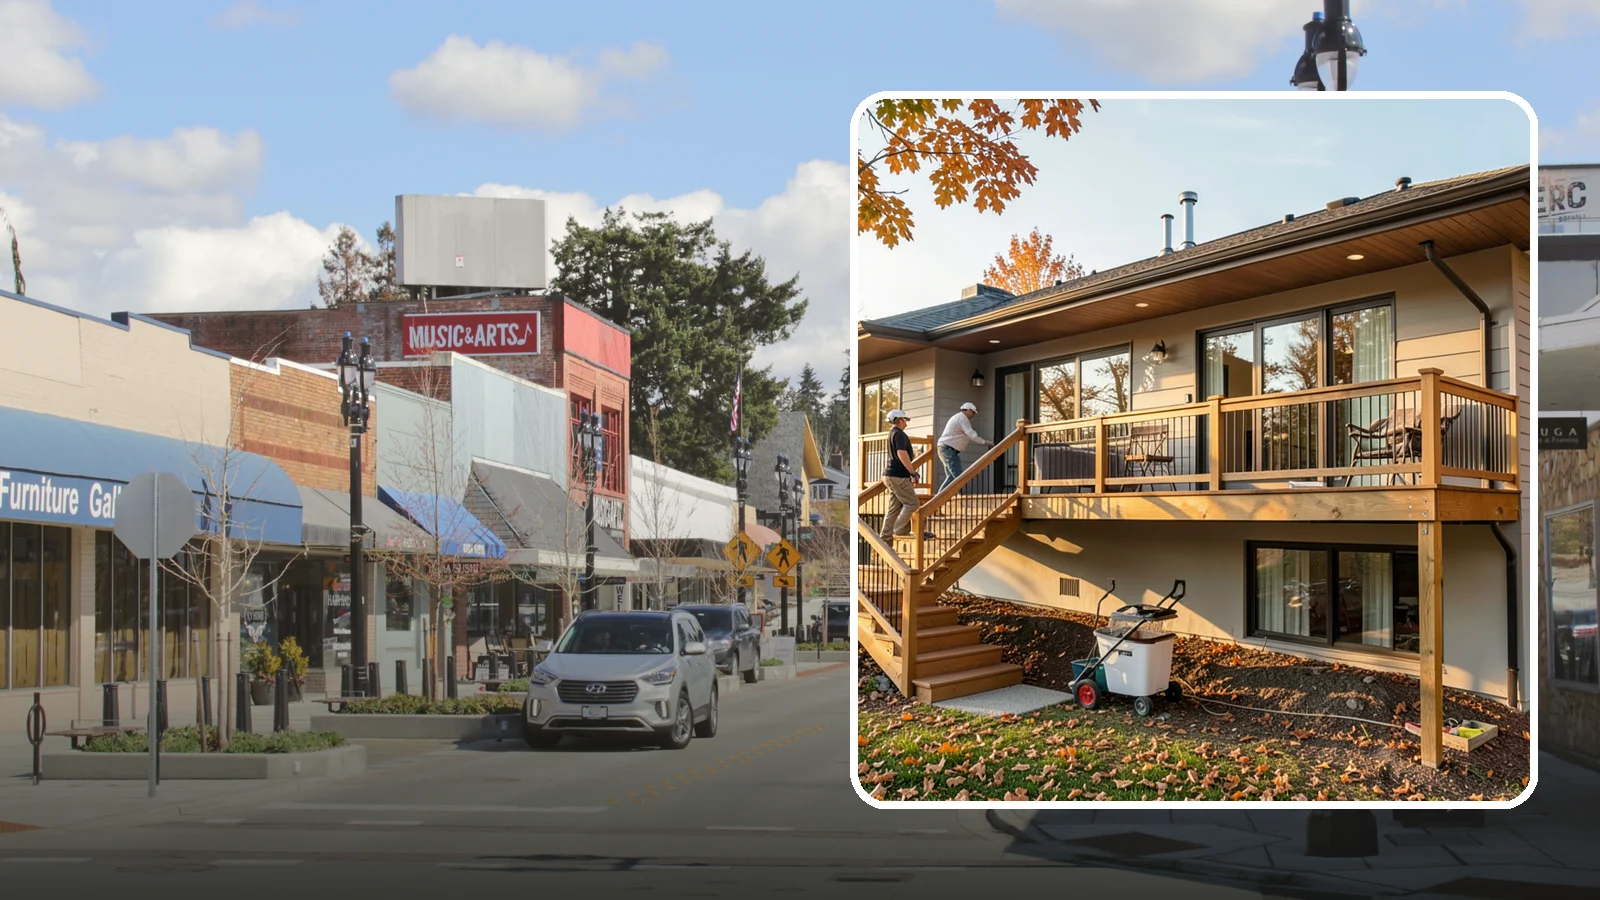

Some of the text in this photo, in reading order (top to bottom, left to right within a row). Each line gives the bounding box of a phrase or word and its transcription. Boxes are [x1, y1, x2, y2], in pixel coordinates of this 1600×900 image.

[1540, 427, 1577, 437] UGA
[0, 471, 79, 515] Furniture
[453, 563, 479, 574] SUSHI
